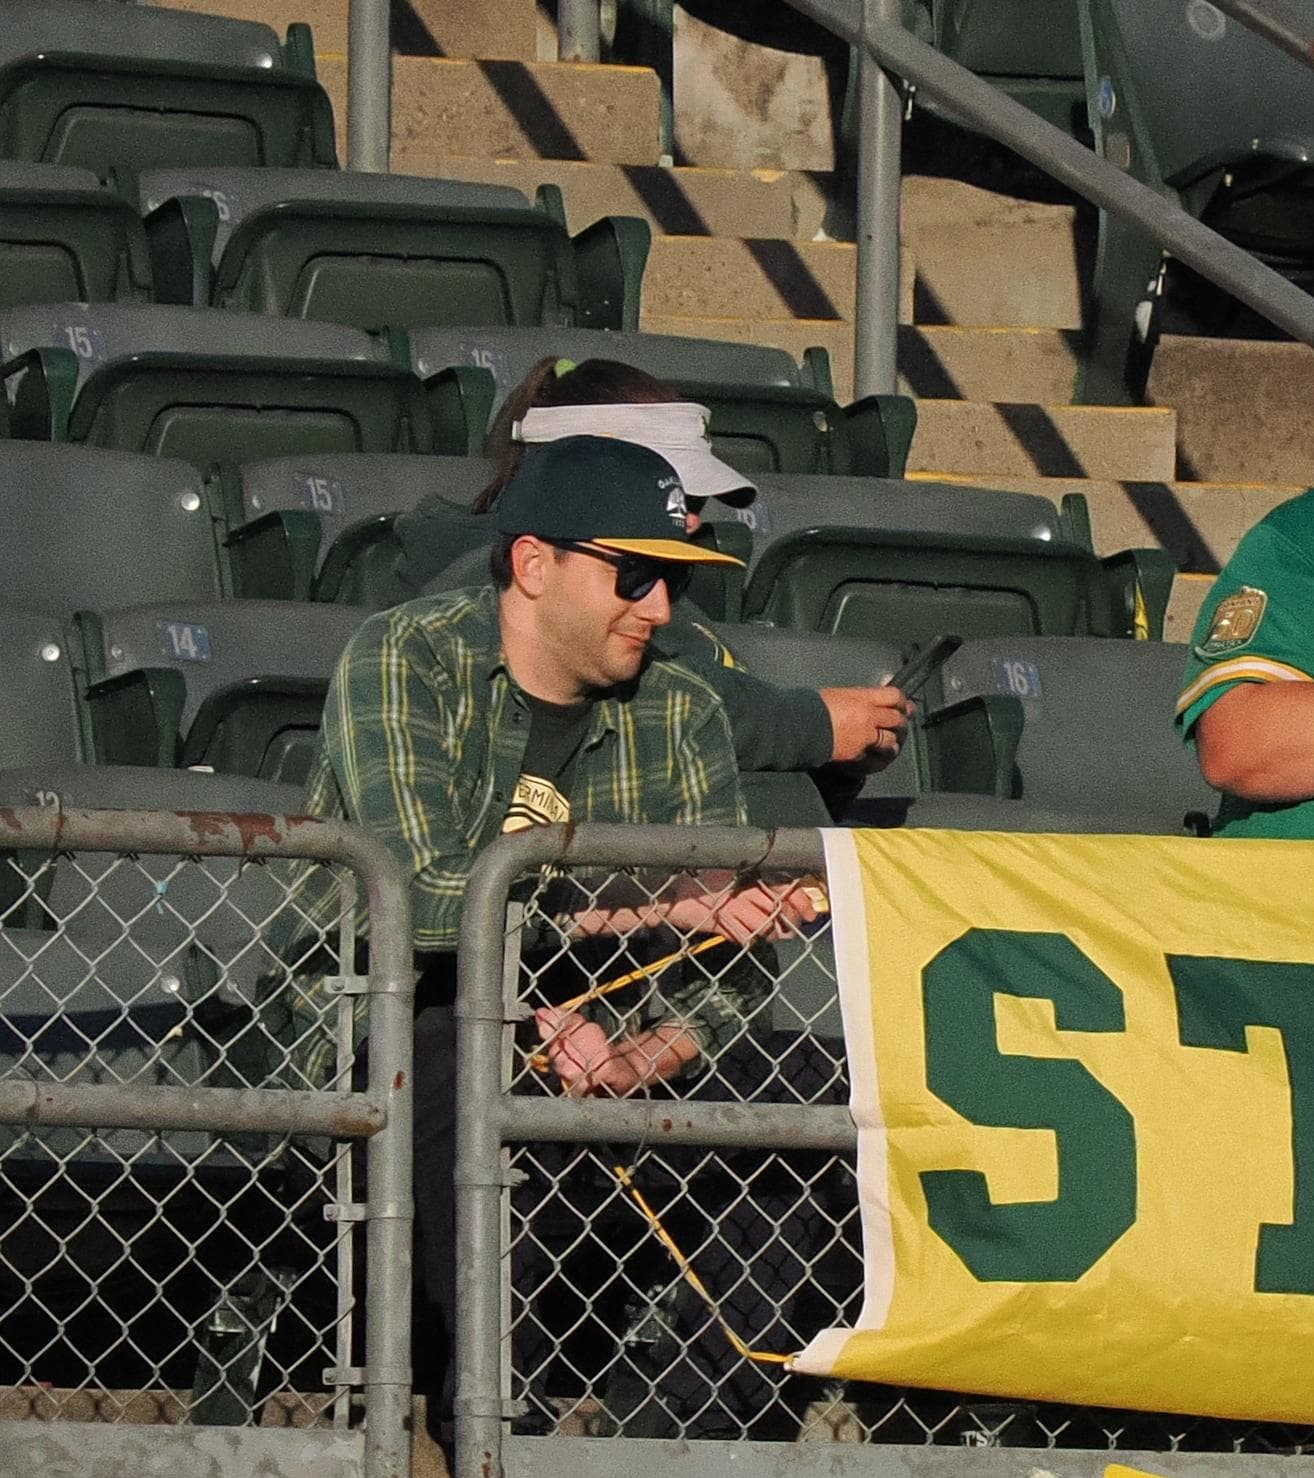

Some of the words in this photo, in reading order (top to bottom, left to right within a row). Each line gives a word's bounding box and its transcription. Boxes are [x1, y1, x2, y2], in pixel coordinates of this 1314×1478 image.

[65, 326, 93, 358] 15
[306, 478, 332, 511] 15
[167, 625, 197, 658] 14
[1004, 662, 1028, 695] 16
